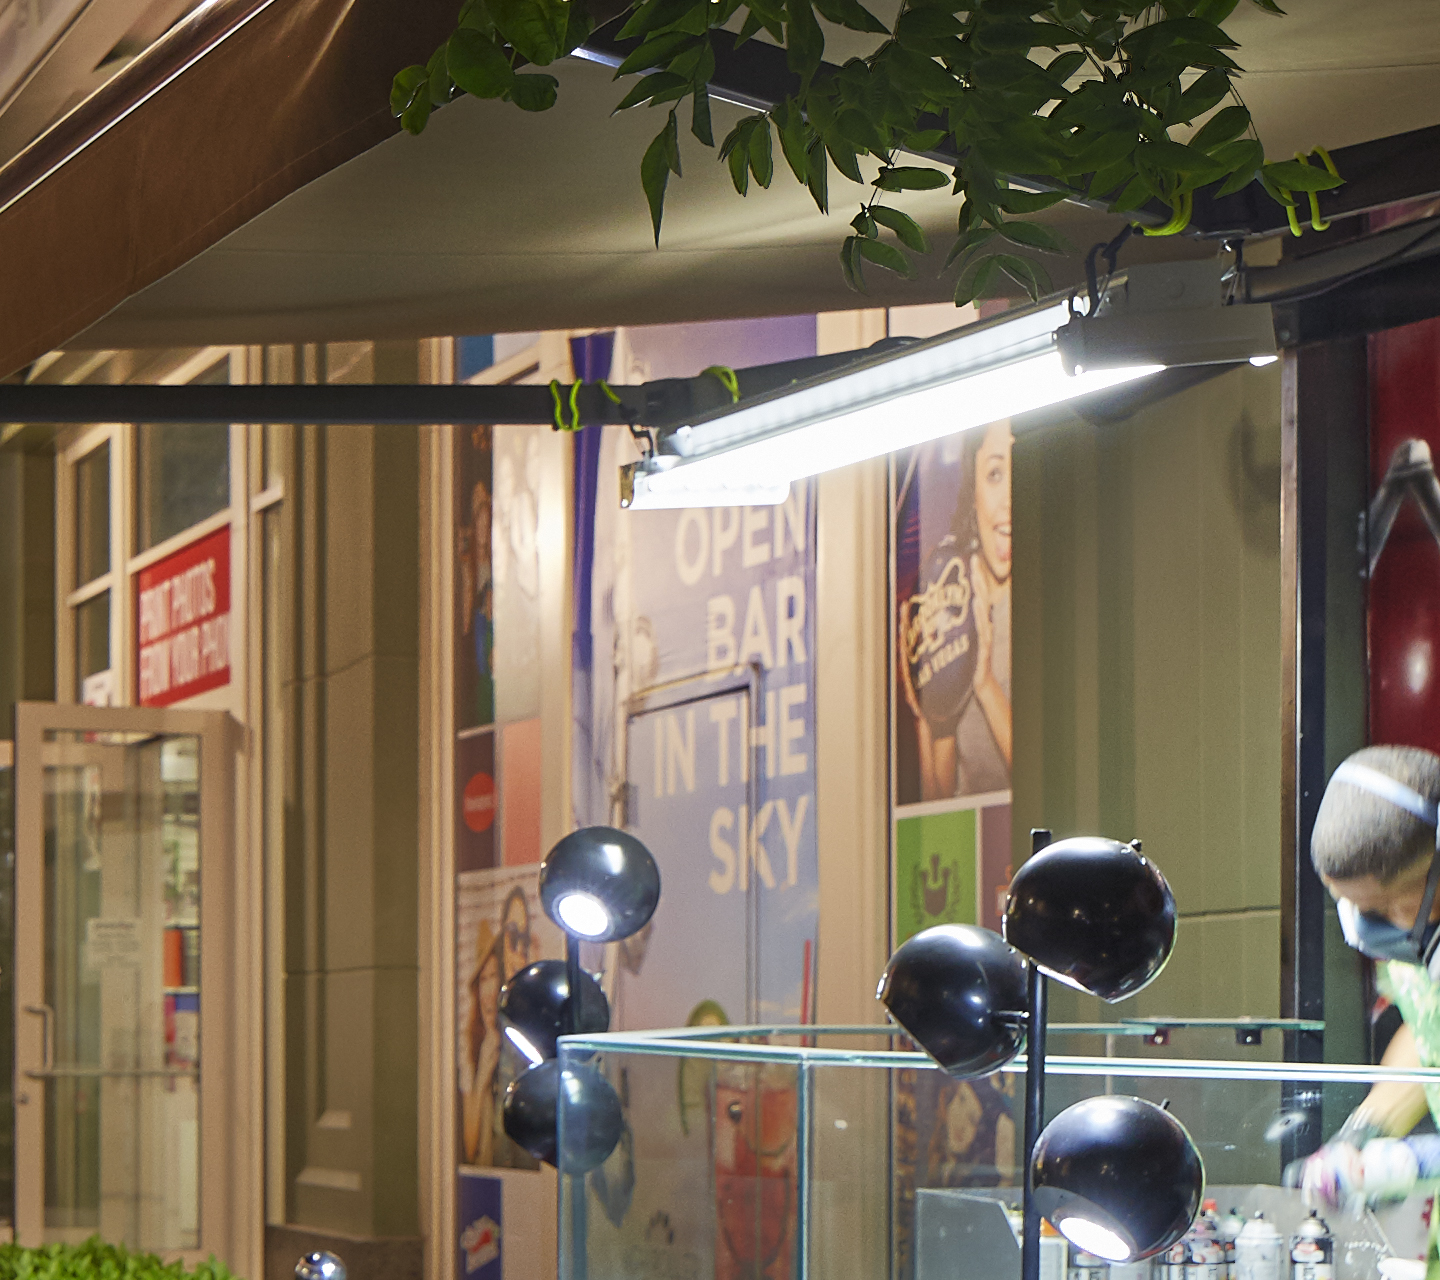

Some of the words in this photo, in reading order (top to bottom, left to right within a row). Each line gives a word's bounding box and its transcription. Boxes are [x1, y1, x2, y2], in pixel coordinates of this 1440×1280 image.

[674, 482, 808, 587] OPEN
[706, 575, 808, 682] BAR
[653, 705, 697, 799] IN
[708, 682, 809, 788] THE
[707, 795, 810, 895] SKY
